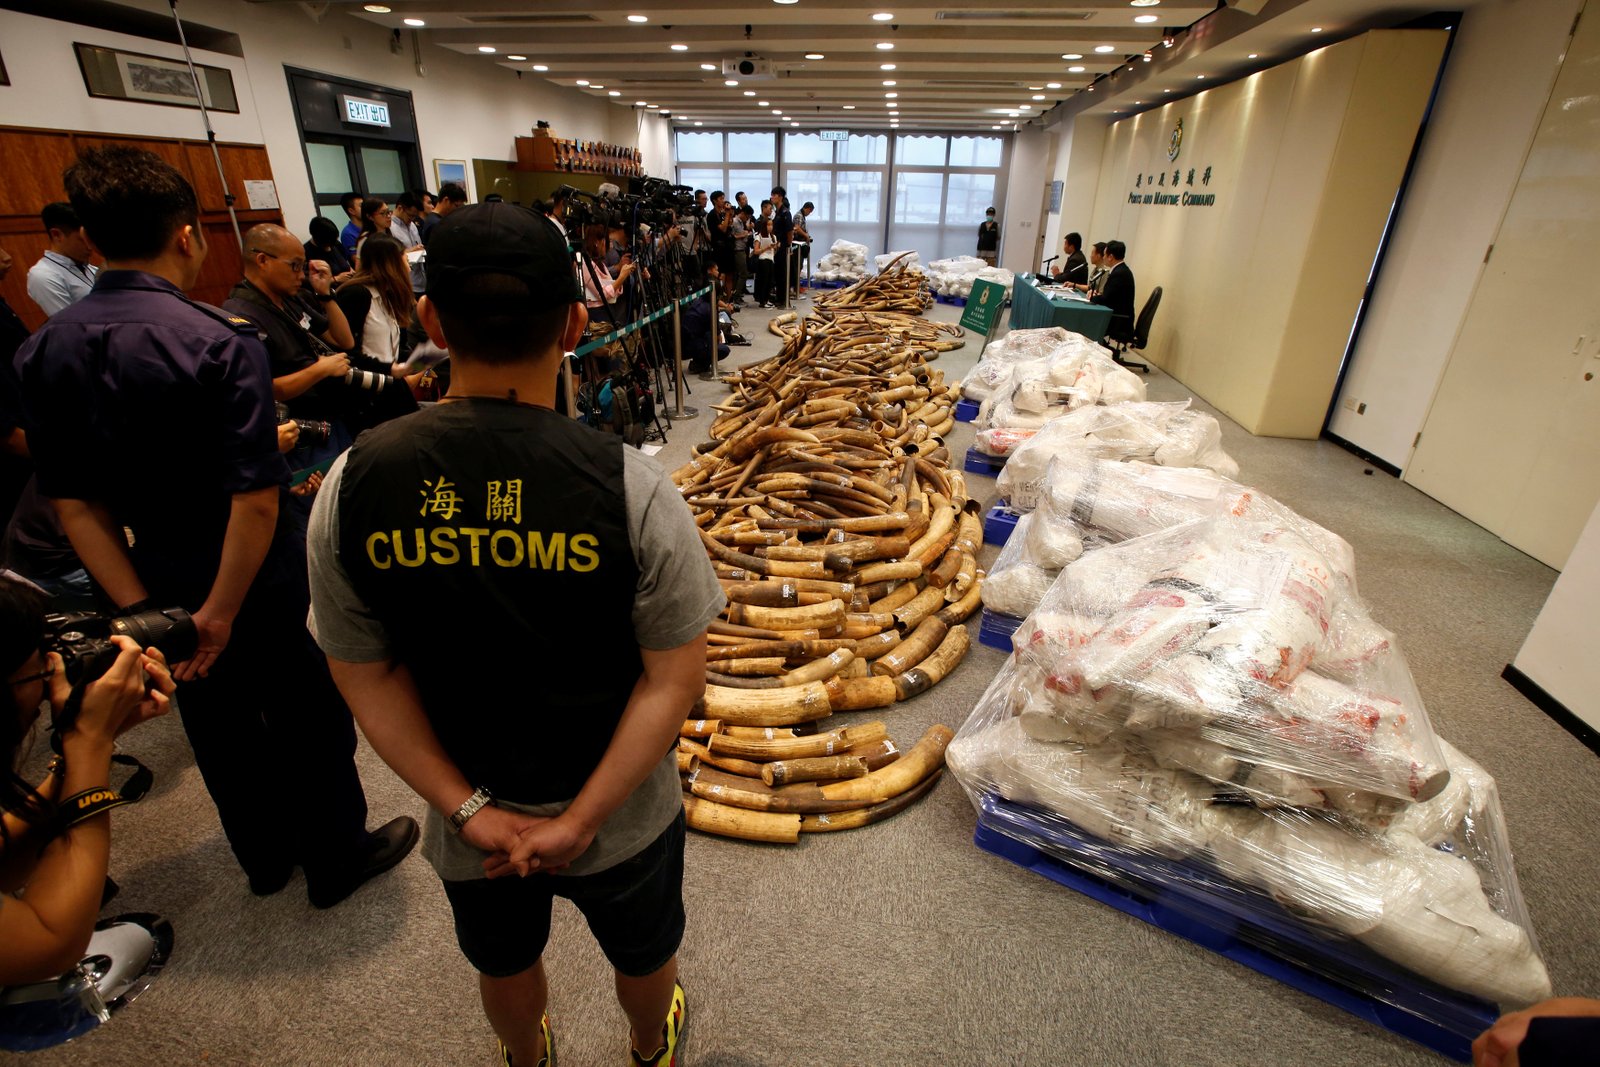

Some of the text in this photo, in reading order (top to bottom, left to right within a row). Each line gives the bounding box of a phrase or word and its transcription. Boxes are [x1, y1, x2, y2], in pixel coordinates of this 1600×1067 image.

[348, 101, 387, 123] EXIT 出口
[419, 475, 524, 525] 海關
[365, 526, 601, 573] CUSTOMS
